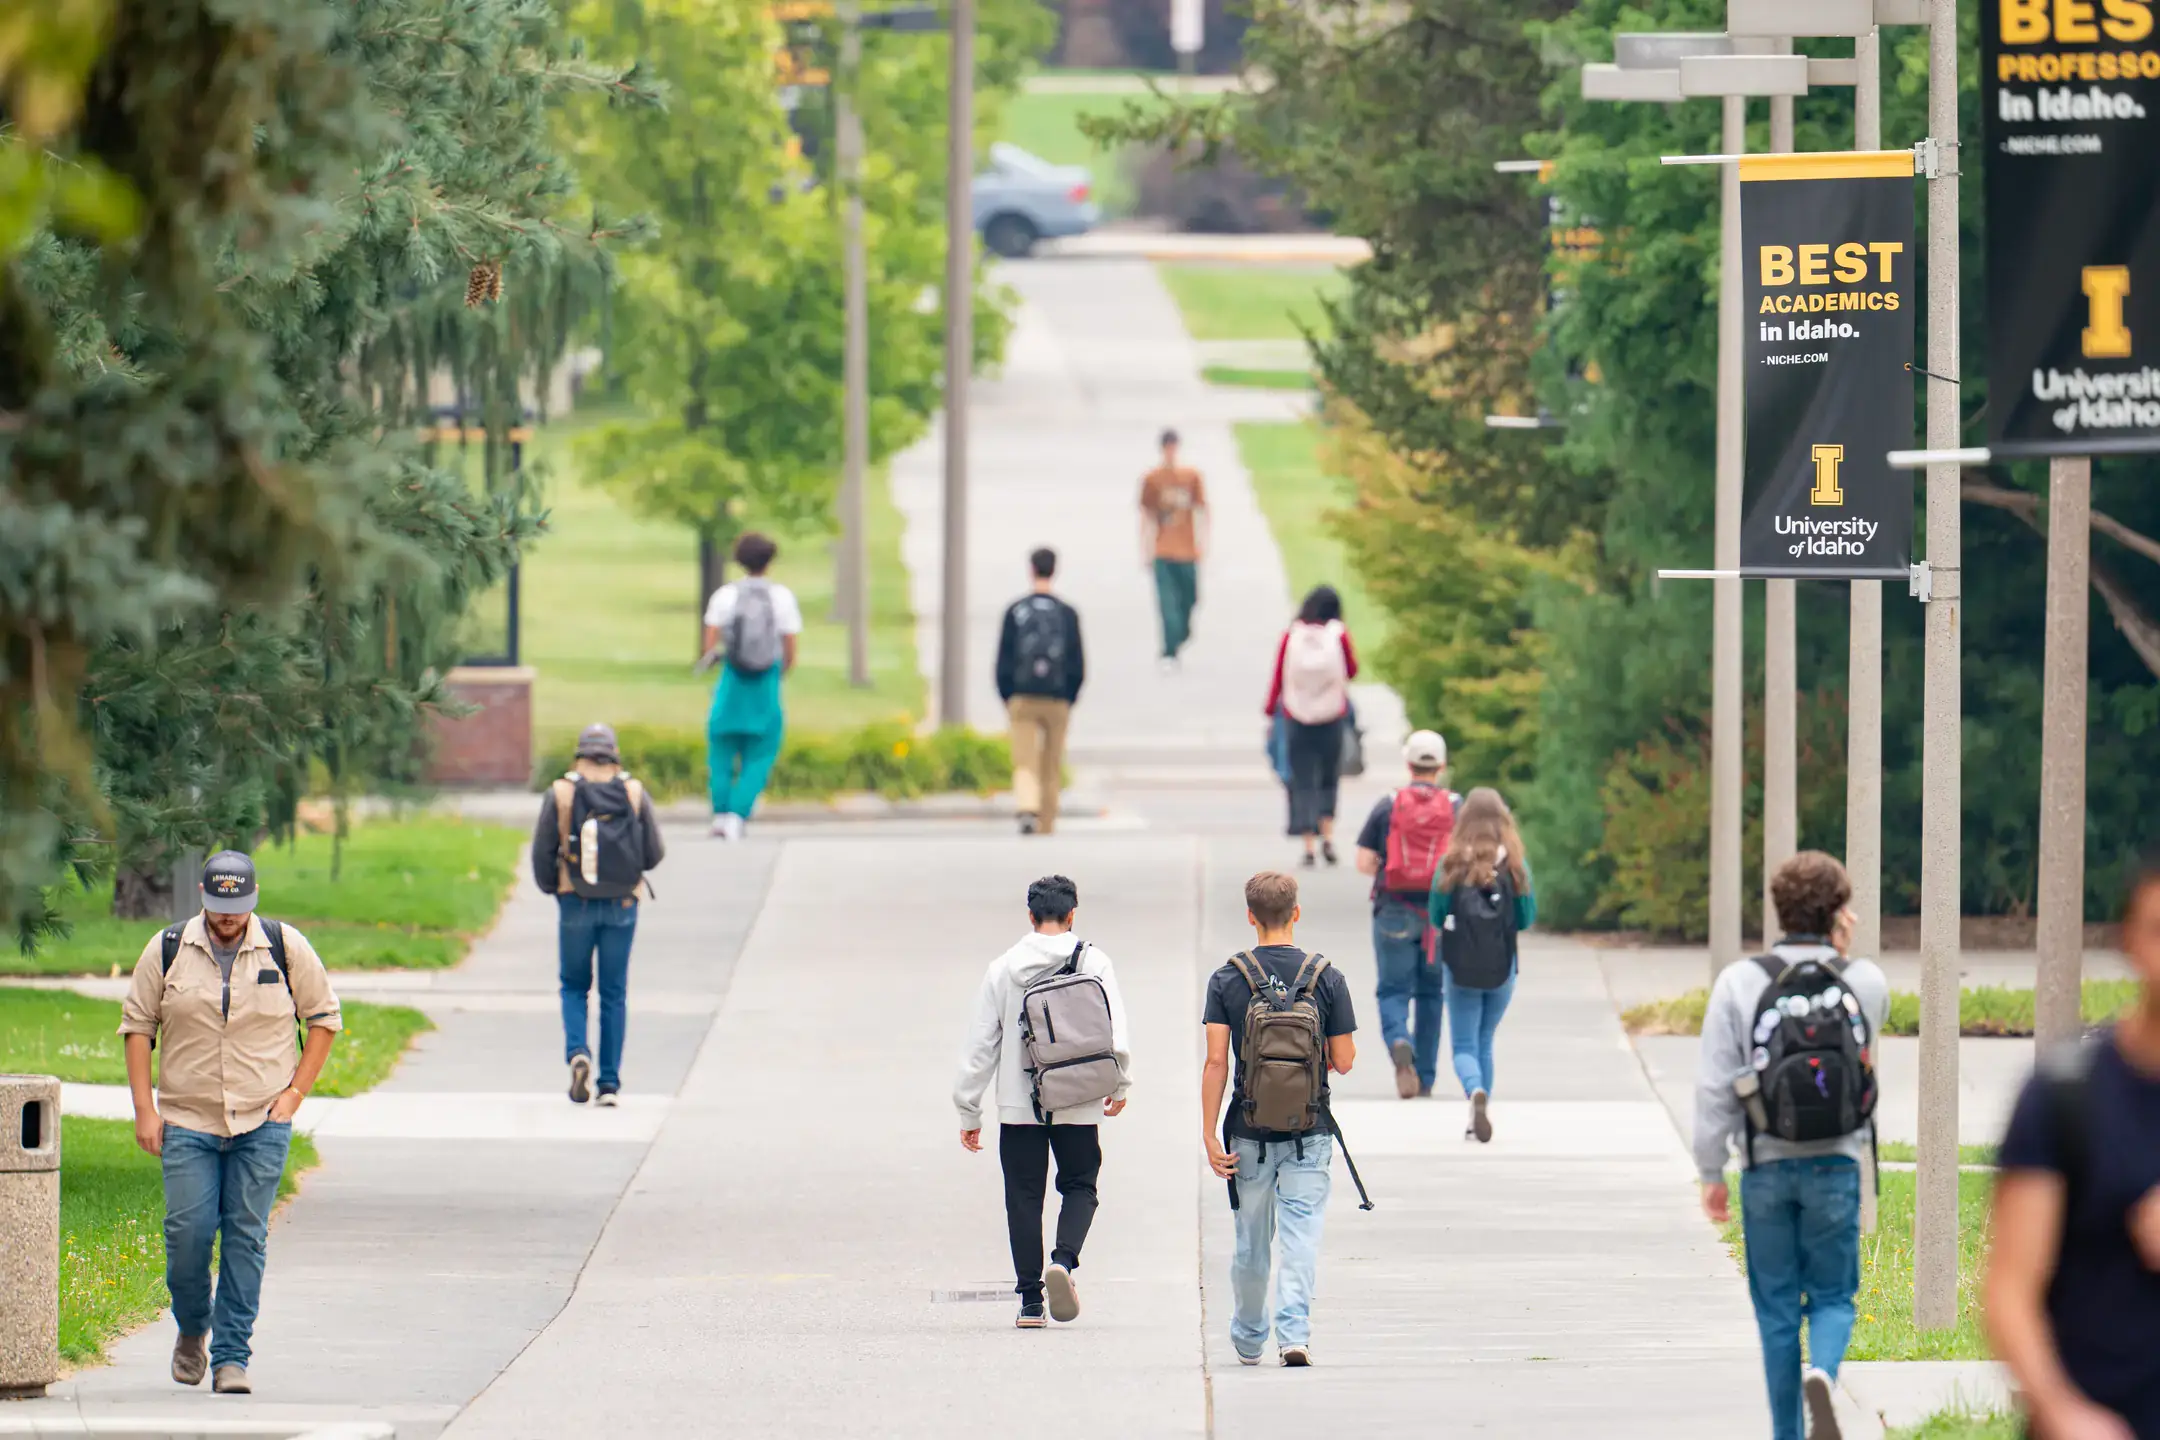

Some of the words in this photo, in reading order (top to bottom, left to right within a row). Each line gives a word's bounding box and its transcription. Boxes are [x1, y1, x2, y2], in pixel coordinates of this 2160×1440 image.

[1998, 51, 2160, 82] PROFESSO
[1998, 88, 2034, 122] in
[2037, 85, 2146, 121] Idaho.
[1760, 242, 1903, 286] BEST
[1760, 292, 1900, 314] ACADEMICS
[2081, 265, 2132, 358] I
[1760, 322, 1783, 342] in
[1788, 319, 1860, 341] Idaho.
[2052, 403, 2078, 434] of
[2079, 397, 2160, 428] Idaho
[1811, 444, 1844, 506] I
[1775, 515, 1879, 542] University
[1788, 541, 1807, 559] of
[1807, 536, 1865, 556] Idaho
[212, 874, 246, 884] ARMADILLO
